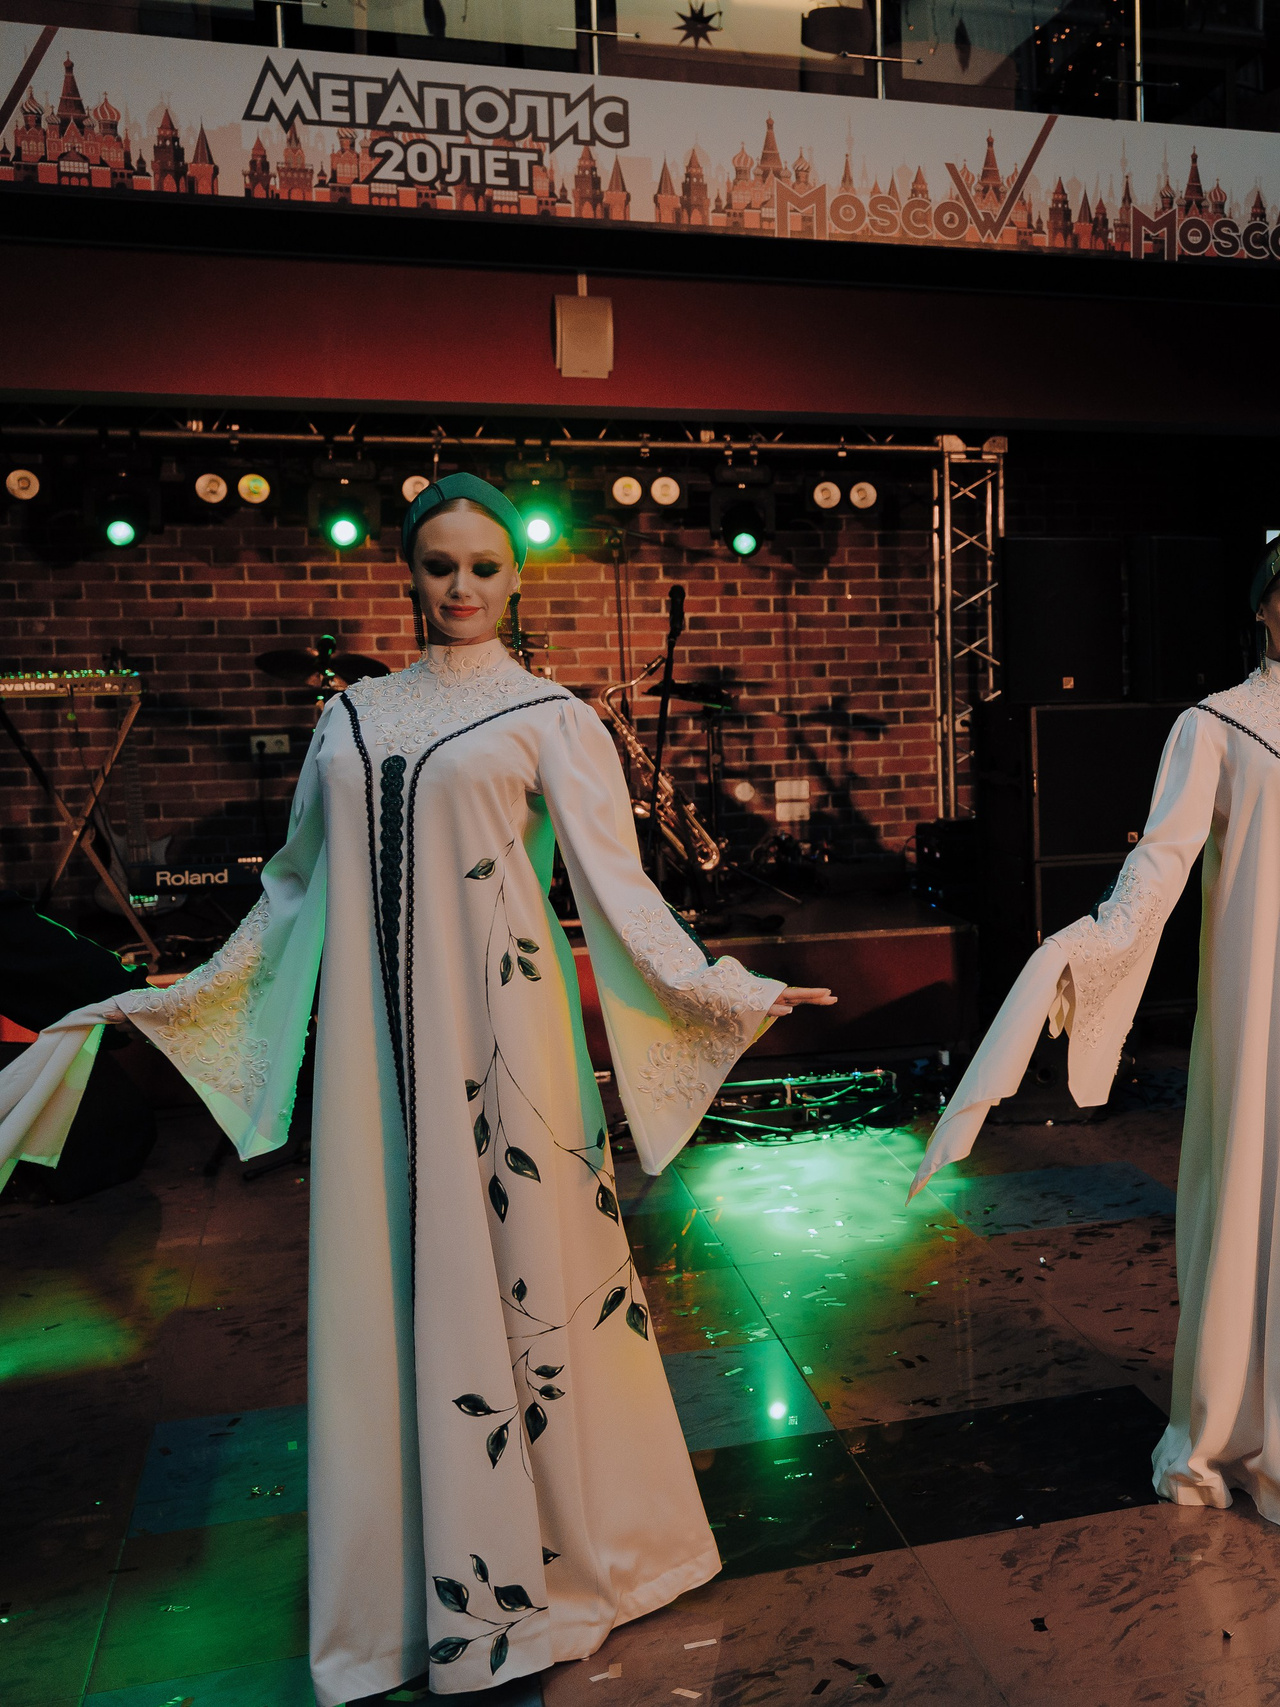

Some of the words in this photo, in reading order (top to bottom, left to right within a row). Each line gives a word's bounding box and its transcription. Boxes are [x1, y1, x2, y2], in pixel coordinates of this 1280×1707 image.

[243, 56, 629, 152] МЕГАПОЛИС
[370, 139, 440, 183] 20
[443, 144, 540, 189] ЛЕТ
[775, 115, 1058, 243] MOSCOW
[156, 868, 228, 887] Roland
